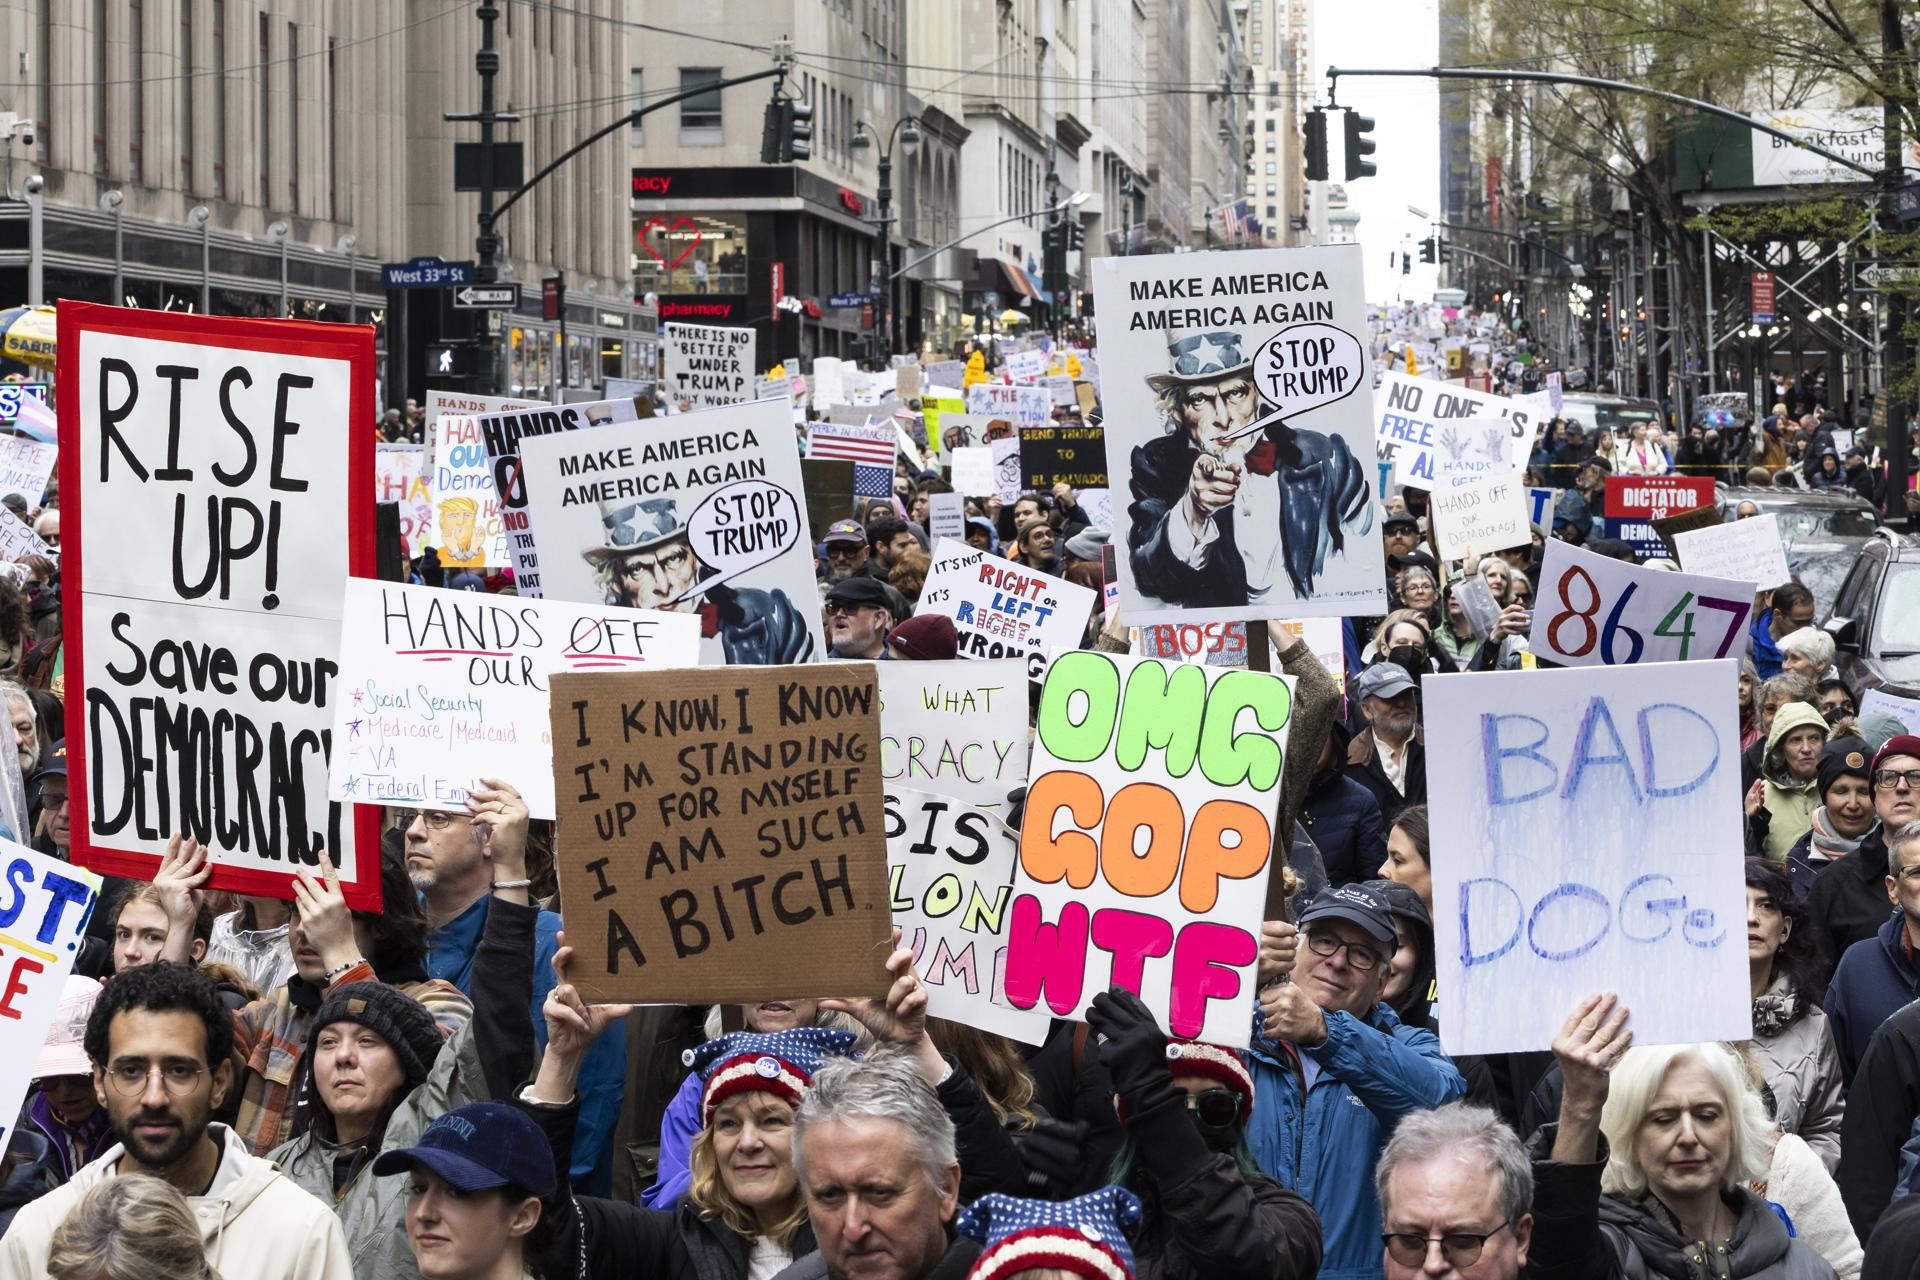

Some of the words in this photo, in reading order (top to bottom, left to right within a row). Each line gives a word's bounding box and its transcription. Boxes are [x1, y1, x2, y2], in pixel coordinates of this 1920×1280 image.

[389, 269, 421, 283] West
[424, 267, 447, 282] 33rd
[450, 267, 464, 281] St
[1130, 277, 1204, 301] MAKE
[1210, 270, 1330, 296] AMERICA
[1867, 270, 1890, 281] ONE
[464, 292, 479, 300] ONE
[488, 291, 507, 300] WAY
[663, 302, 731, 318] pharmacy
[1129, 305, 1247, 331] AMERICA
[1252, 300, 1335, 325] AGAIN
[668, 326, 708, 340] THERE
[711, 330, 725, 343] IS
[730, 332, 750, 344] NO
[689, 358, 741, 373] UNDER
[1269, 337, 1336, 370] STOP
[676, 372, 745, 392] TRUMP
[990, 390, 1018, 404] THE
[1267, 365, 1349, 398] TRUMP
[437, 397, 487, 412] HANDS
[1387, 382, 1423, 413] NO
[1433, 393, 1484, 419] ONE
[100, 357, 314, 492] RISE
[1023, 429, 1054, 441] SEND
[1061, 428, 1104, 440] TRUMP
[1379, 413, 1434, 447] FREE
[559, 447, 634, 477] MAKE
[641, 428, 760, 464] AMERICA
[1057, 449, 1075, 460] TO
[1443, 461, 1492, 471] HANDS
[561, 471, 680, 507] AMERICA
[686, 457, 767, 488] AGAIN
[1031, 474, 1047, 486] EL
[714, 489, 781, 526] STOP
[1436, 490, 1481, 514] HANDS
[1488, 484, 1508, 504] OFF
[1623, 487, 1697, 508] DICTATOR
[503, 511, 529, 532] NO
[705, 518, 788, 556] TRUMP
[1620, 524, 1661, 541] DEMO
[172, 492, 281, 611] UP!
[935, 557, 960, 575] IT'S
[962, 552, 984, 568] NOT
[979, 563, 1047, 601] RIGHT
[1043, 597, 1058, 609] OR
[383, 588, 543, 650] HANDS
[927, 589, 950, 605] IT'S
[956, 600, 1031, 642] RIGHT
[1028, 638, 1041, 648] OR
[991, 592, 1053, 628] LEFT
[1155, 620, 1246, 658] BOSS
[105, 612, 238, 694] Save
[249, 652, 339, 708] our
[469, 655, 549, 692] OUR
[362, 679, 411, 714] Social
[418, 685, 483, 723] Security
[571, 699, 591, 748] I
[621, 694, 727, 743] KNOW,
[734, 687, 753, 735] I
[778, 681, 873, 727] KNOW
[923, 683, 1005, 715] WHAT
[1038, 651, 1292, 792] OMG
[369, 745, 397, 771] VA
[574, 758, 654, 803] I'M
[677, 732, 868, 786] STANDING
[1480, 695, 1721, 808] BAD
[362, 772, 428, 800] Federal
[594, 801, 637, 841] UP
[658, 786, 721, 827] FOR
[741, 767, 861, 815] MYSELF
[585, 856, 617, 902] I
[644, 827, 726, 881] AM
[757, 801, 866, 858] SUCH
[1019, 770, 1271, 914] GOP
[606, 908, 647, 975] A
[1003, 894, 1258, 1040] WTF
